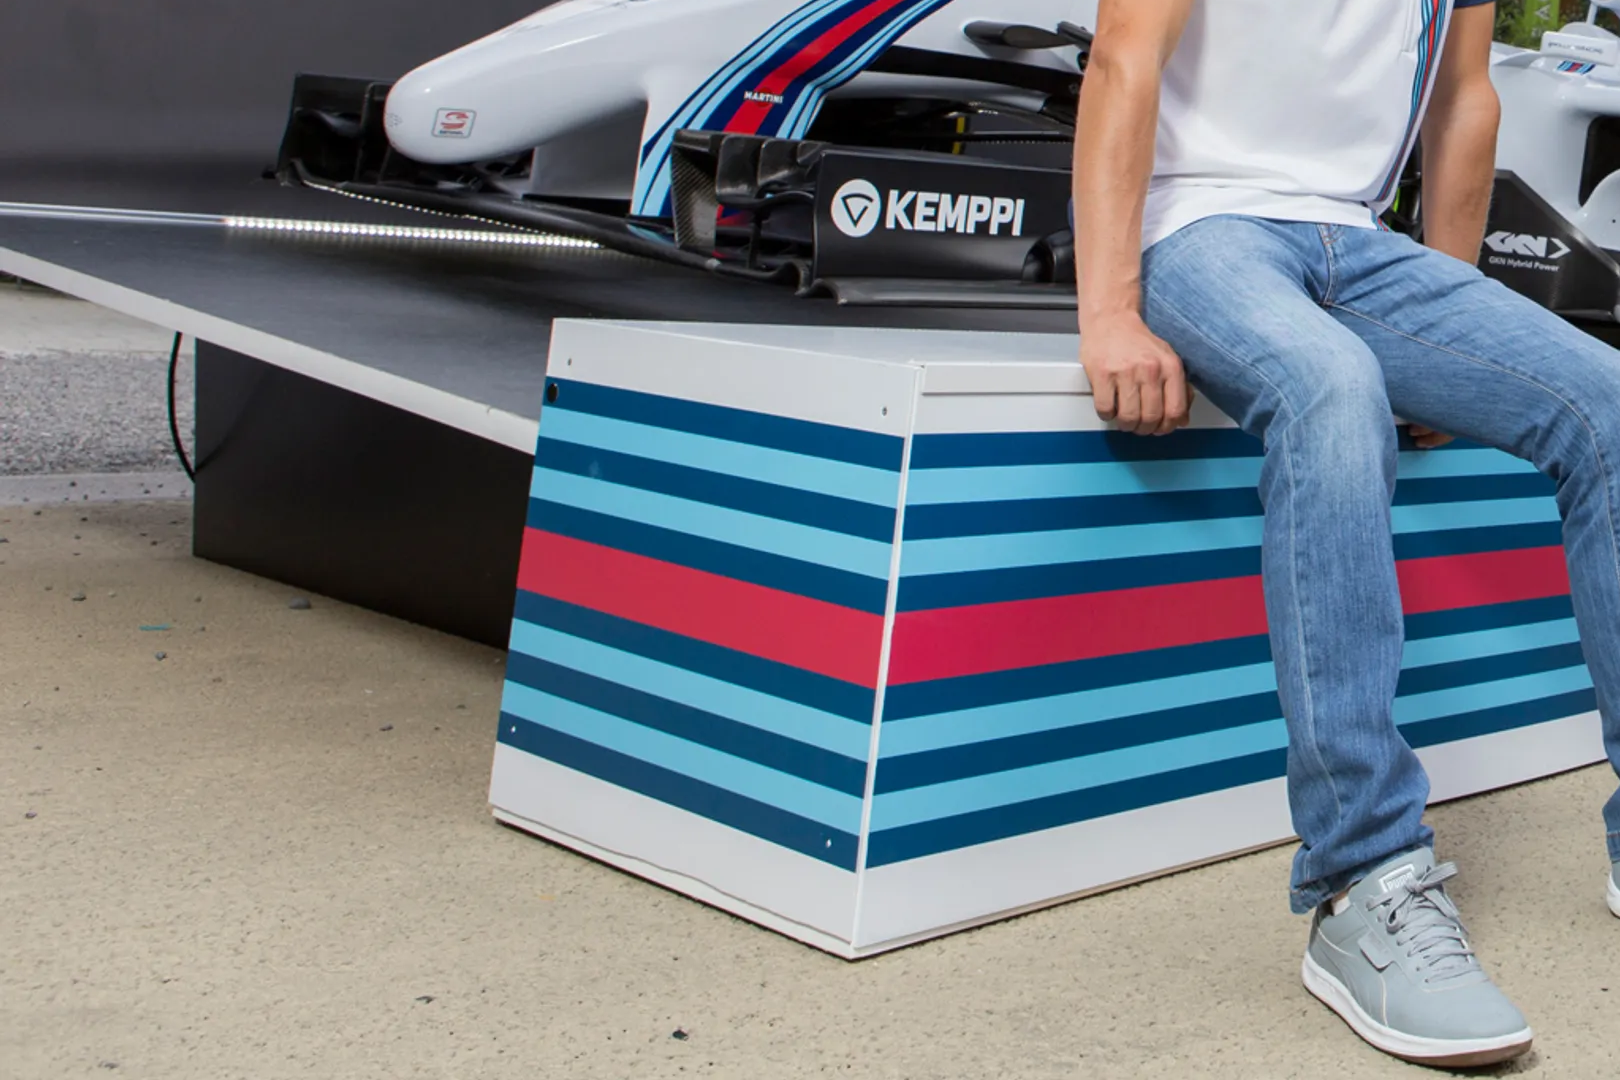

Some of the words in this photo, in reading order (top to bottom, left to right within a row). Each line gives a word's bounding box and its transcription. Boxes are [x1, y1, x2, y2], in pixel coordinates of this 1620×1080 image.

[743, 90, 783, 104] MARTINI
[885, 189, 1025, 236] KEMPPI
[1488, 255, 1507, 266] GKN
[1507, 258, 1533, 270] Hybrid
[1533, 261, 1560, 273] Power
